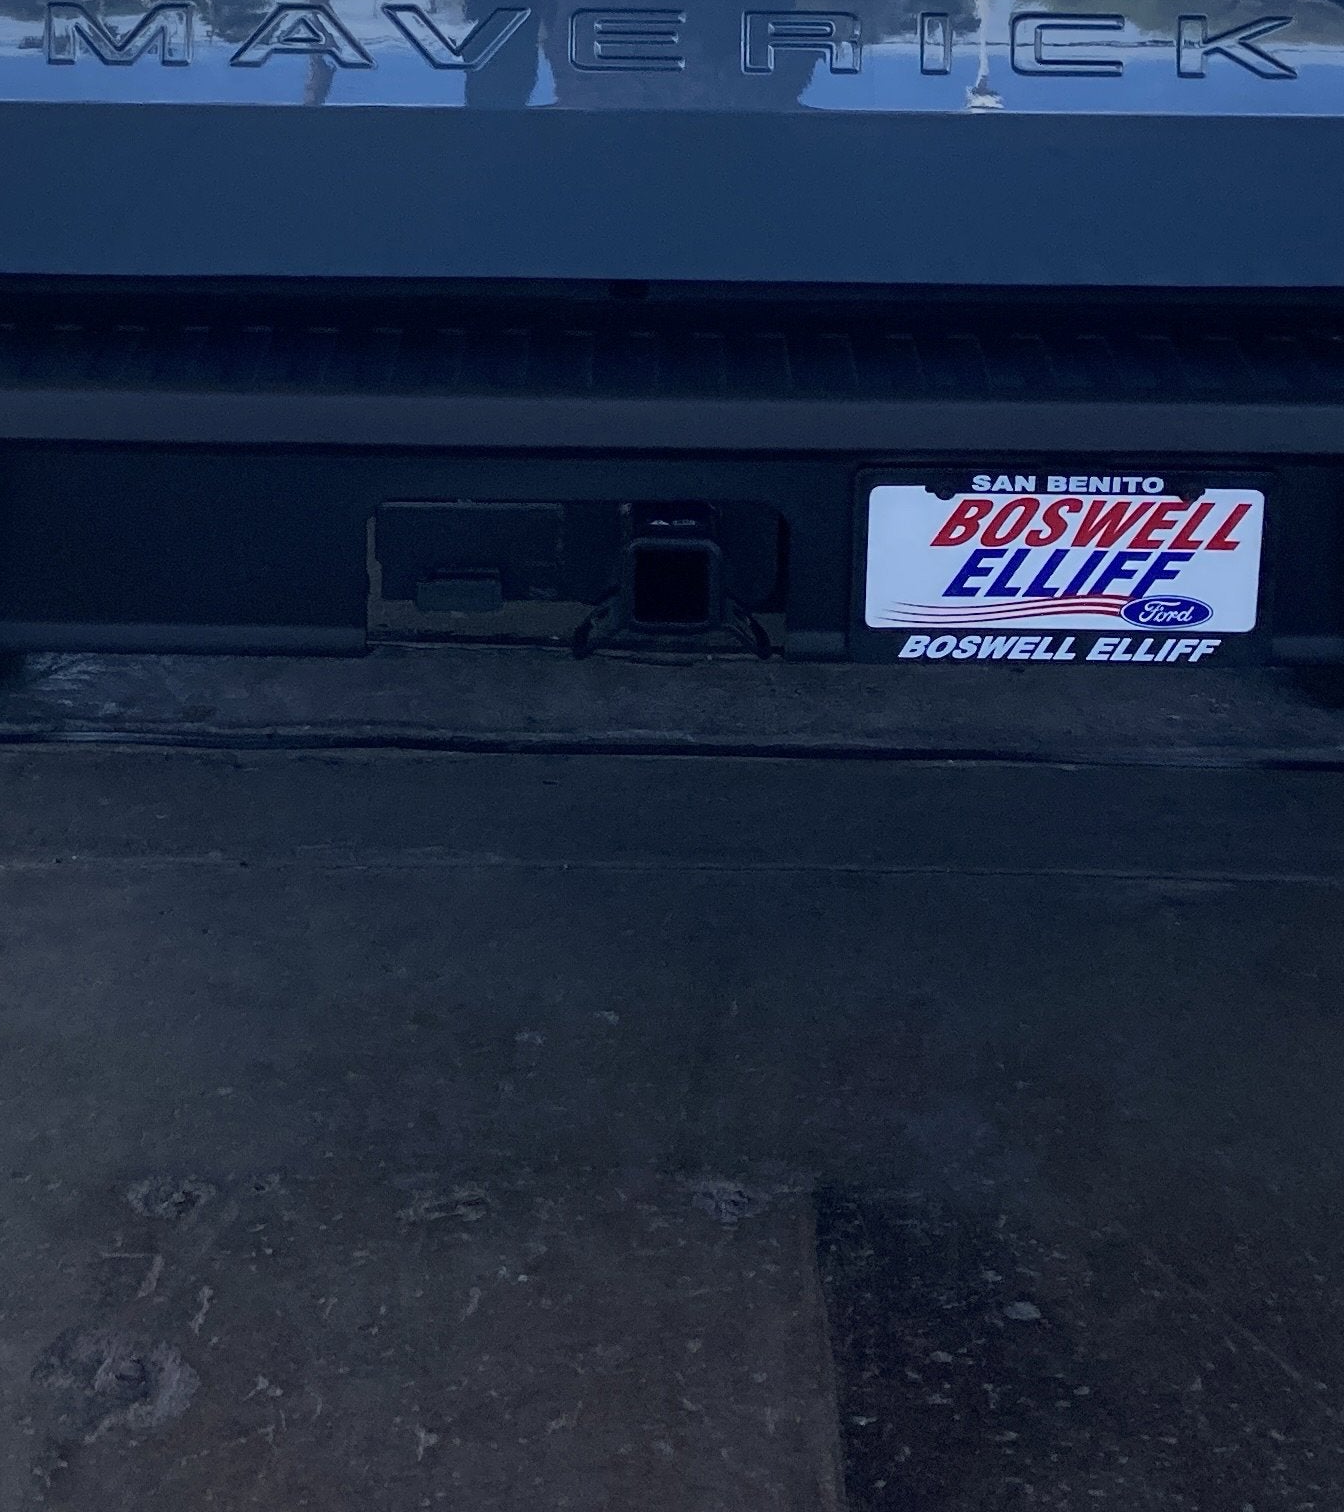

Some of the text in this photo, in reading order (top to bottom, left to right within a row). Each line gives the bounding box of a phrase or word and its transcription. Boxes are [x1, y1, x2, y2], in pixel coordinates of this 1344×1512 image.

[44, 0, 1300, 82] MAVERICK
[971, 475, 1164, 494] SAN BENITO
[930, 497, 1252, 551] BOSWELL
[942, 548, 1196, 599] ELLIFF
[1138, 602, 1194, 624] Ford
[898, 635, 1221, 663] BOSWELL ELLIFF
